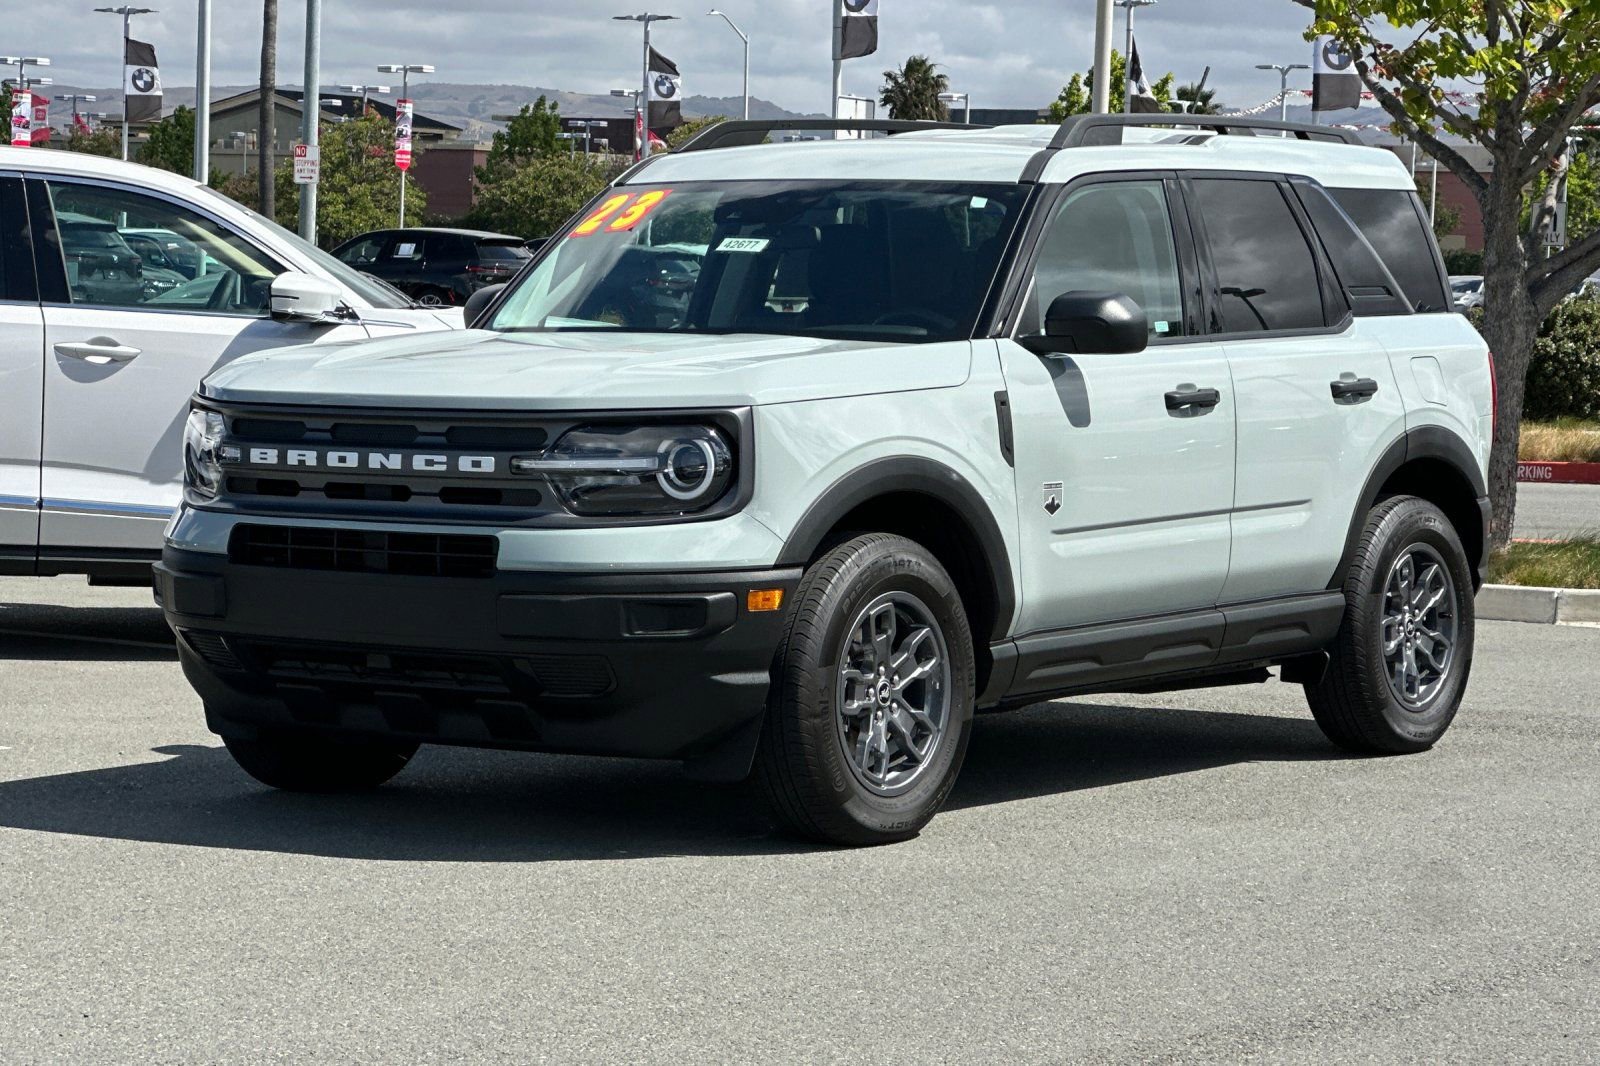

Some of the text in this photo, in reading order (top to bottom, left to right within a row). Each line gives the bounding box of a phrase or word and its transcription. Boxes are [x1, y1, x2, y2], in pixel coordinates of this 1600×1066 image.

[295, 146, 306, 156] NO
[295, 159, 318, 167] STOPPING
[307, 167, 317, 175] TIME
[573, 189, 668, 235] 23
[1544, 232, 1561, 243] NLY
[723, 239, 761, 250] 42677
[249, 447, 496, 473] BRONCO
[1516, 464, 1553, 480] RKING
